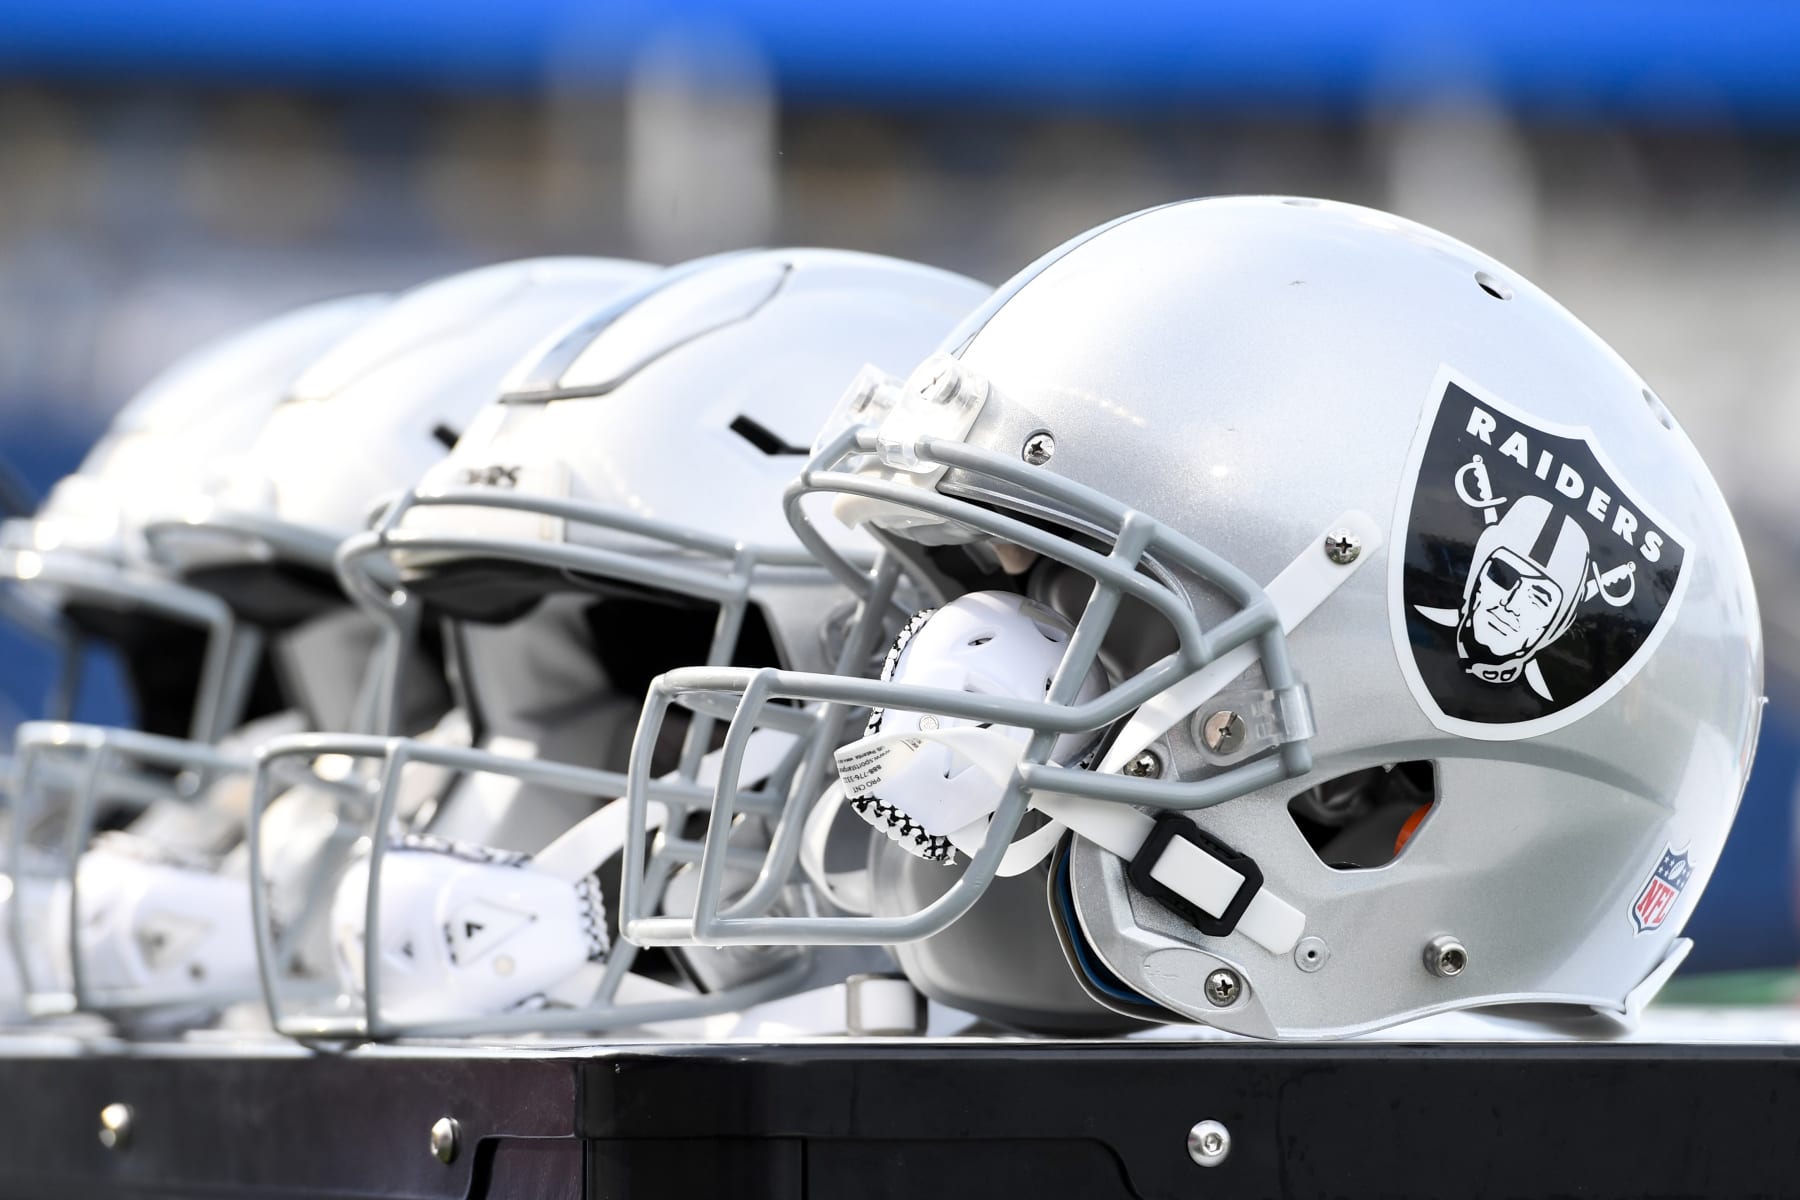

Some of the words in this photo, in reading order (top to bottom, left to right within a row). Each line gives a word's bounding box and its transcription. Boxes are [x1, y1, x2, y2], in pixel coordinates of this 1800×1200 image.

[1466, 406, 1664, 562] RAIDERS
[865, 776, 881, 788] PRO
[1637, 879, 1675, 924] NFL
